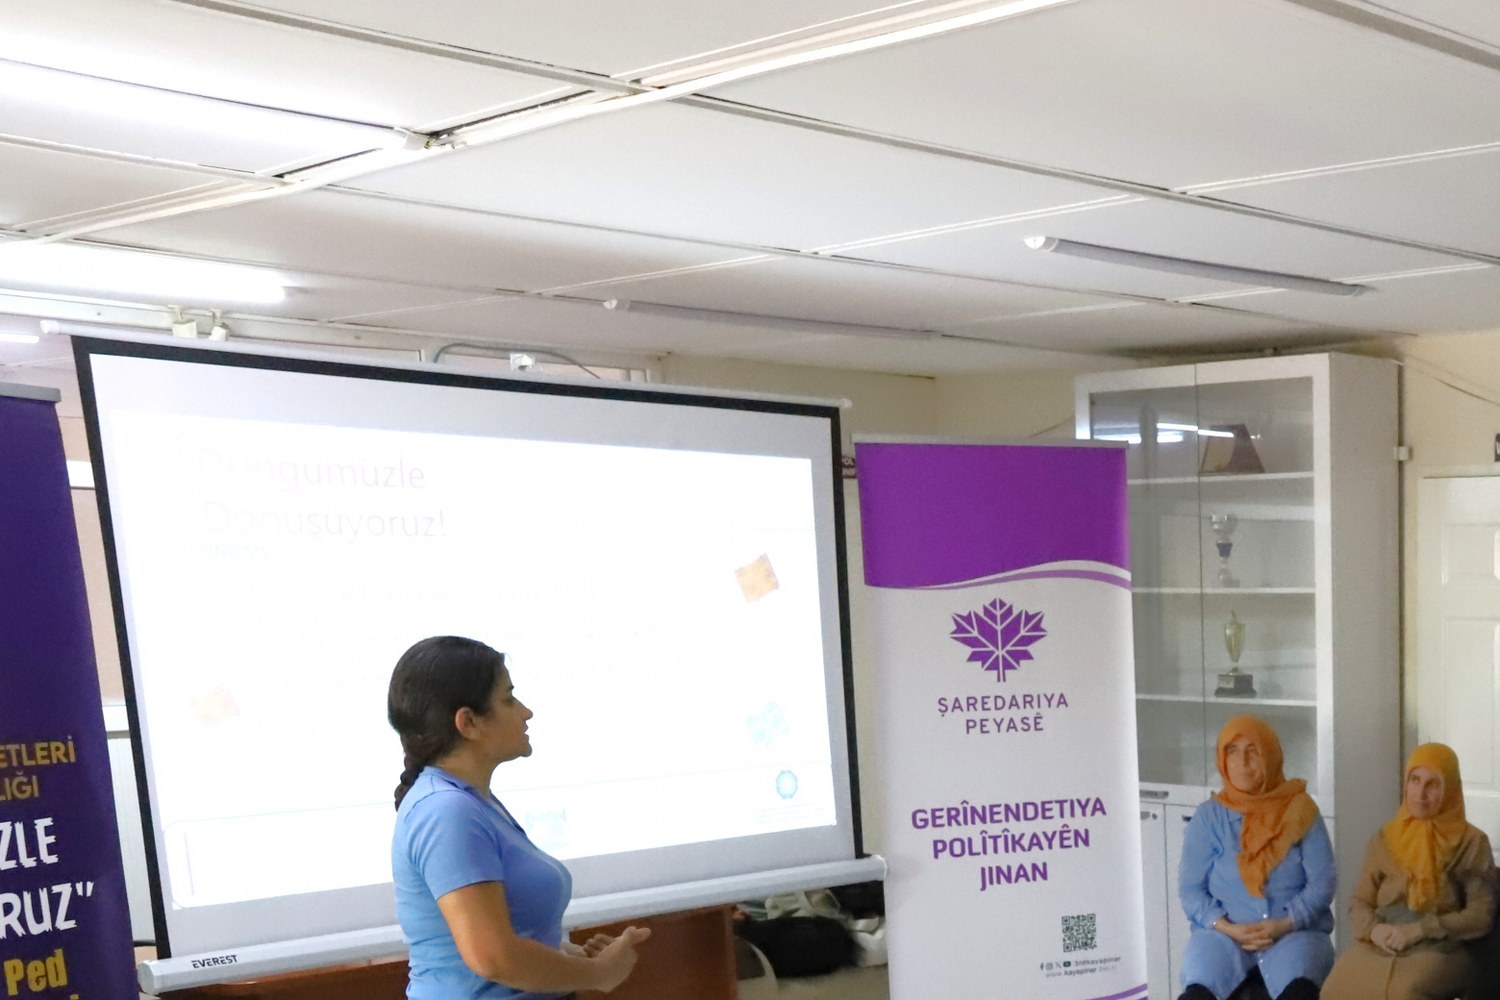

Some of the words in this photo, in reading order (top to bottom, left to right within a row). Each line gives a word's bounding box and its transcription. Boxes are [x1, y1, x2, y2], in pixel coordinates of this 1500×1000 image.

[937, 693, 1069, 717] ŞAREDARIYA
[965, 711, 1044, 735] PEYASÊ
[911, 797, 1107, 830] GERÎNENDETIYA
[932, 823, 1090, 860] POLÎTÎKAYÊN
[979, 862, 1048, 892] JINAN
[4, 948, 69, 997] Ped
[191, 954, 238, 969] EVEREST
